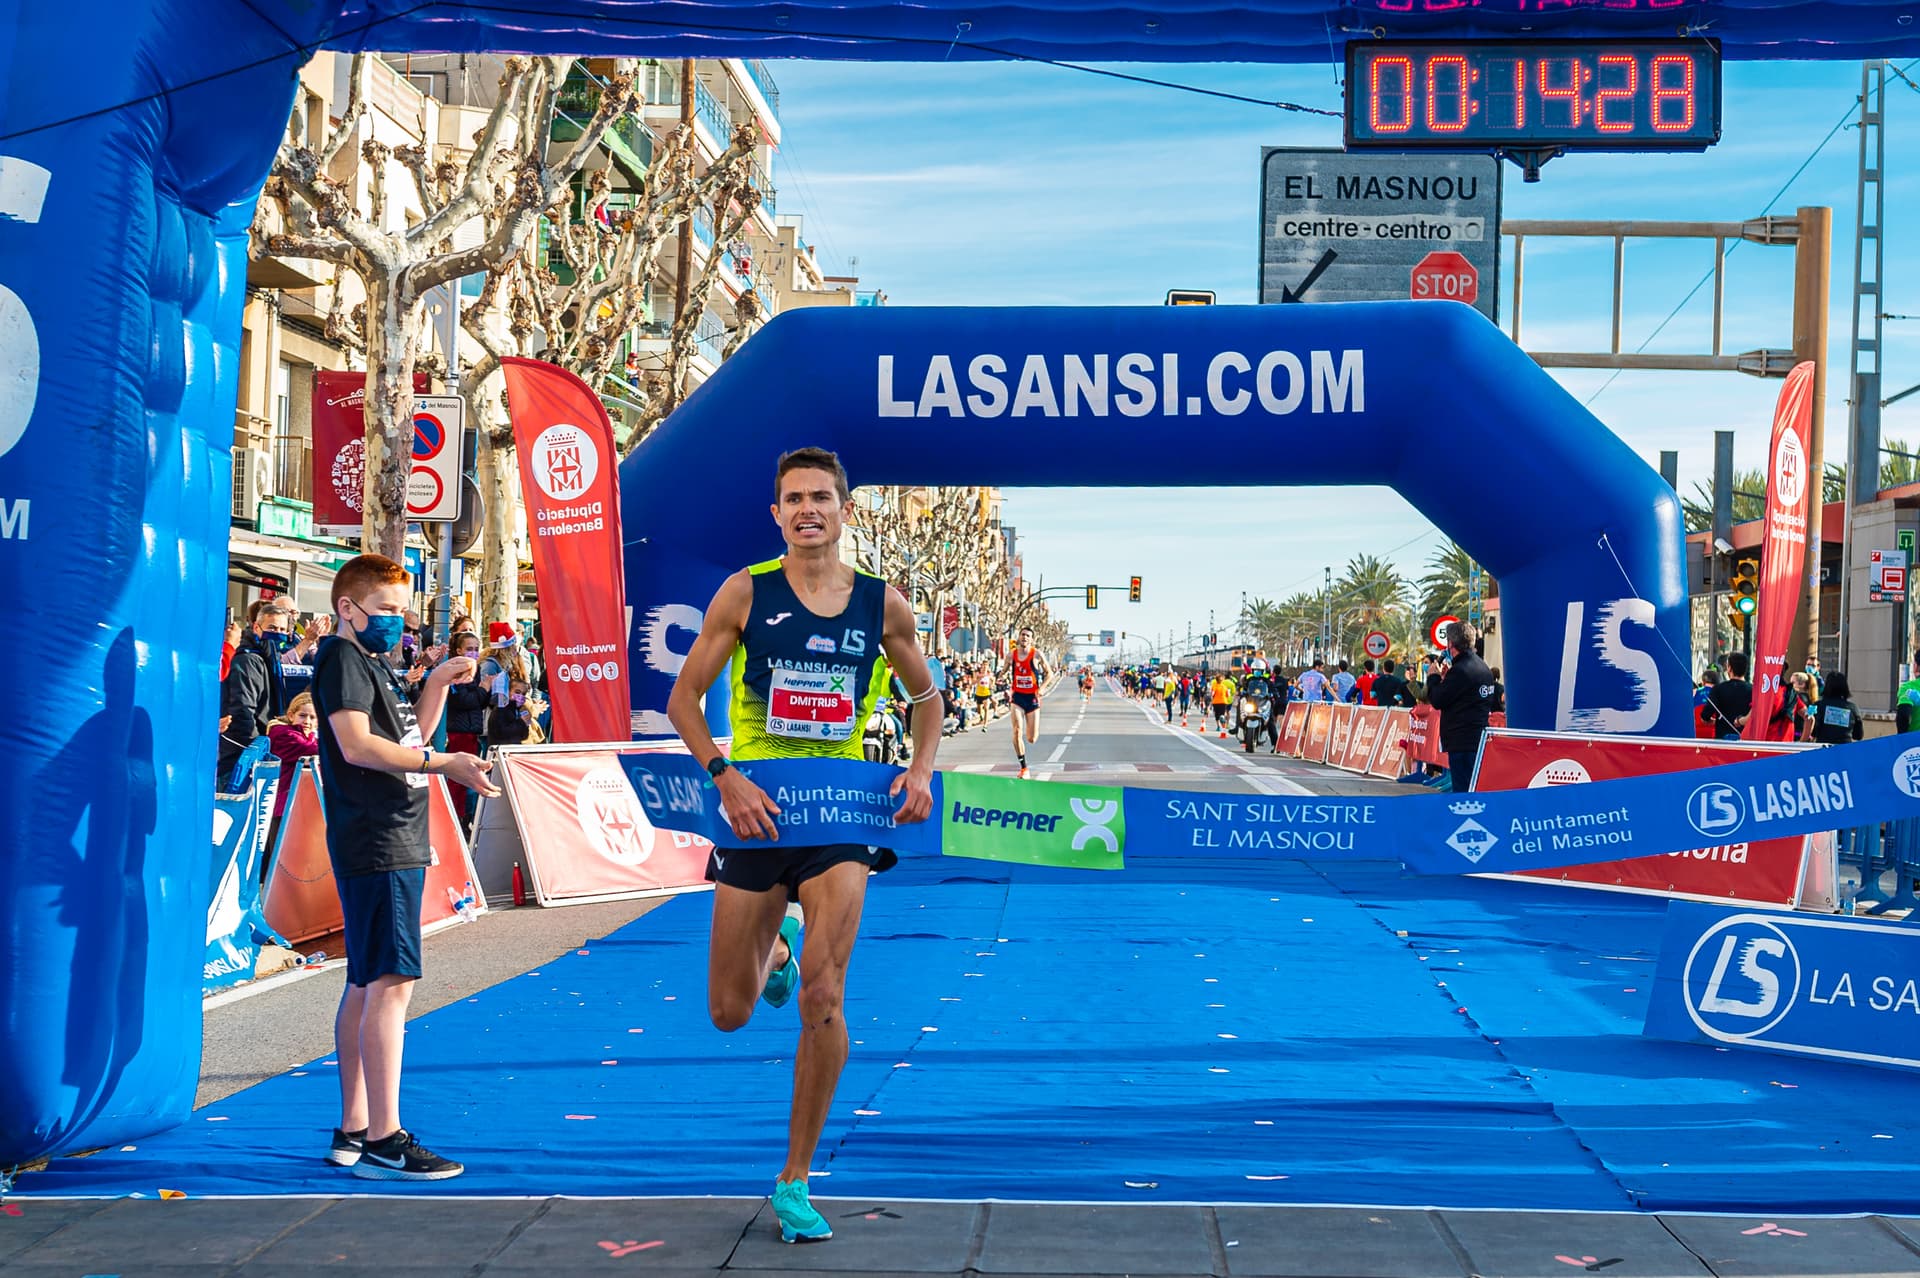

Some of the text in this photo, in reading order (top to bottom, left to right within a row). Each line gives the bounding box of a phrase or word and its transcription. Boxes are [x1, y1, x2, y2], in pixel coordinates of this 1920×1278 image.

[1371, 55, 1695, 132] 00:14:28
[1285, 176, 1477, 200] EL MASNOU
[1416, 274, 1473, 297] STOP
[878, 350, 1364, 418] LASANSI.COM
[841, 628, 866, 653] LS
[767, 657, 858, 674] LASANSI.COM
[1555, 597, 1661, 733] LS
[810, 708, 817, 721] 1
[786, 722, 811, 733] LASANSI
[776, 785, 895, 807] Ajuntament
[1699, 771, 1854, 829] LS LASANSI
[777, 807, 896, 829] del Masnou
[952, 802, 1063, 833] Heppner
[1166, 800, 1376, 824] SANT SILVESTRE
[1510, 806, 1629, 835] Ajuntament
[1192, 828, 1354, 850] EL MASNOU
[1512, 828, 1633, 855] del Masnou
[1699, 935, 1786, 1018] LS
[1809, 969, 1856, 1007] LA
